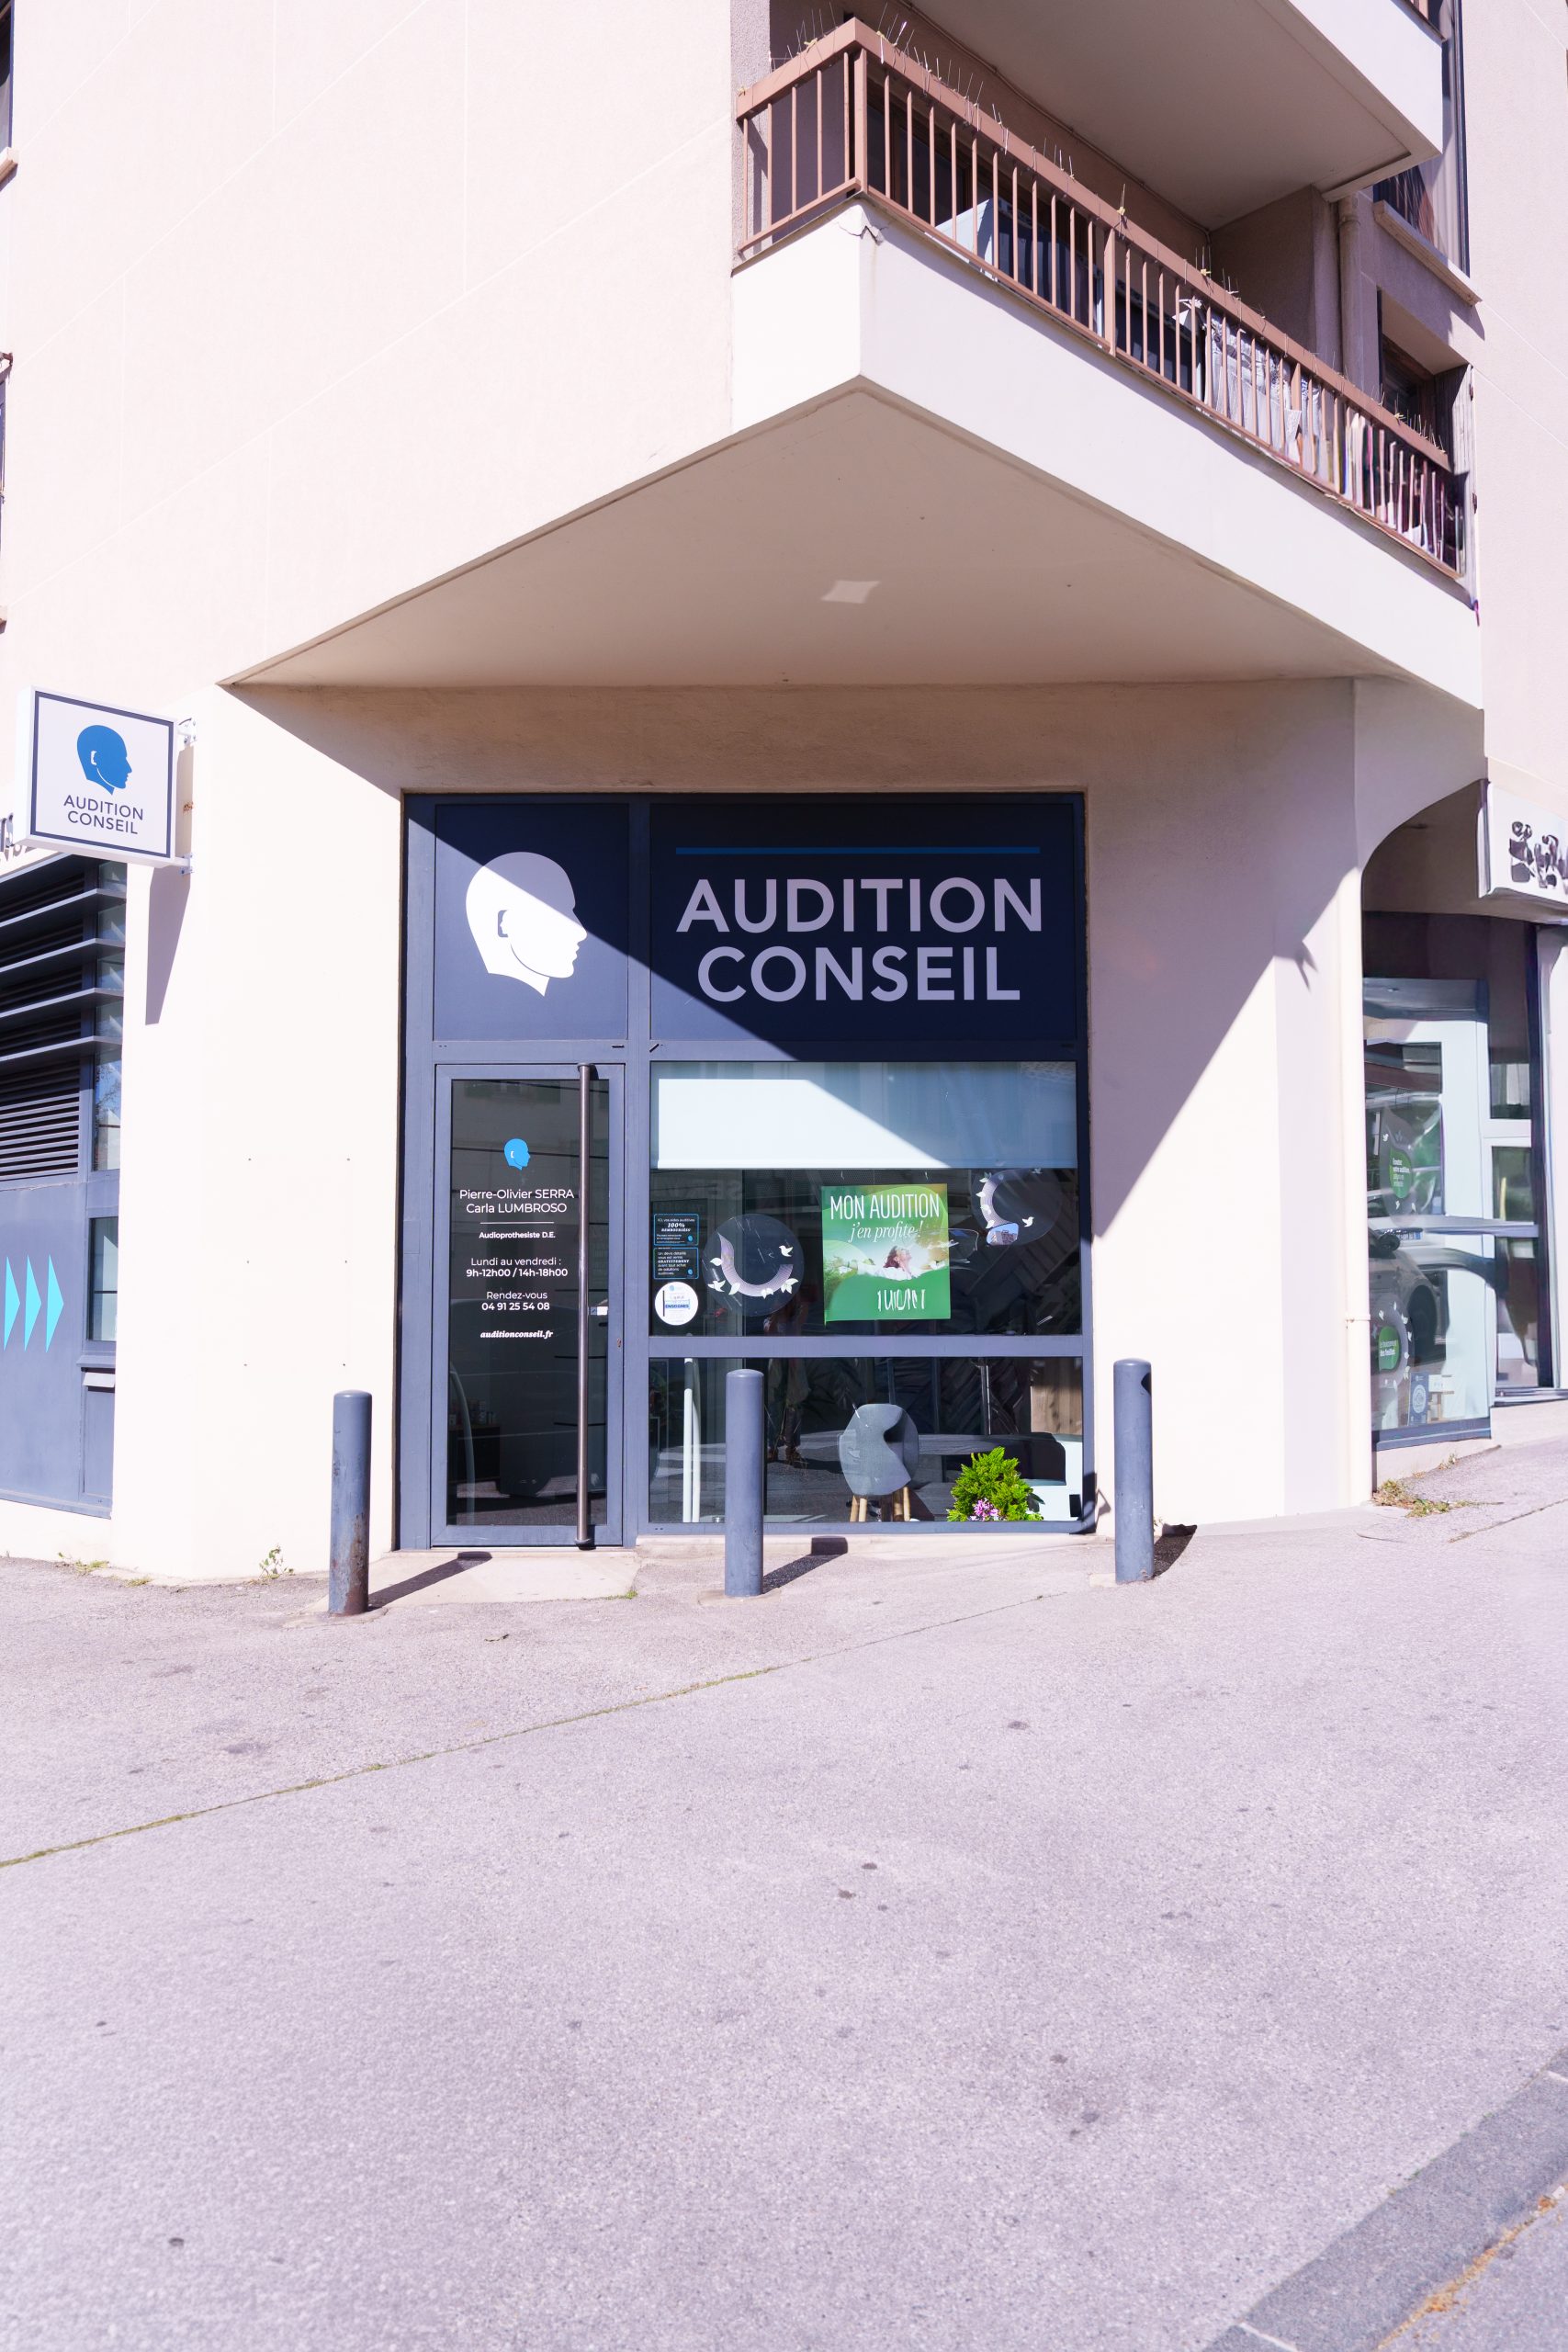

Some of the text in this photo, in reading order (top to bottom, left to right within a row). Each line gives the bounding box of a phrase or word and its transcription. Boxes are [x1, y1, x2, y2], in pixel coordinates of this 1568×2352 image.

[63, 795, 143, 820] AUDITION
[67, 810, 138, 834] CONSEIL
[676, 877, 1042, 933] AUDITION
[698, 946, 1021, 1002] CONSEIL
[459, 1189, 574, 1199] Pierre-Olivier SERRA
[466, 1203, 568, 1213] Carla LUMBROSO
[829, 1193, 940, 1220] MON AUDITION
[848, 1222, 871, 1243] j'en
[873, 1220, 915, 1243] profite
[470, 1258, 498, 1266] Lundi
[514, 1257, 557, 1265] vendredi
[466, 1268, 511, 1277] 9h-12h00
[518, 1268, 568, 1277] 14h-18h00
[486, 1291, 548, 1299] Rendez-vous
[481, 1302, 550, 1311] 04 91 25 54 08
[479, 1329, 554, 1340] auditionconseil.fr
